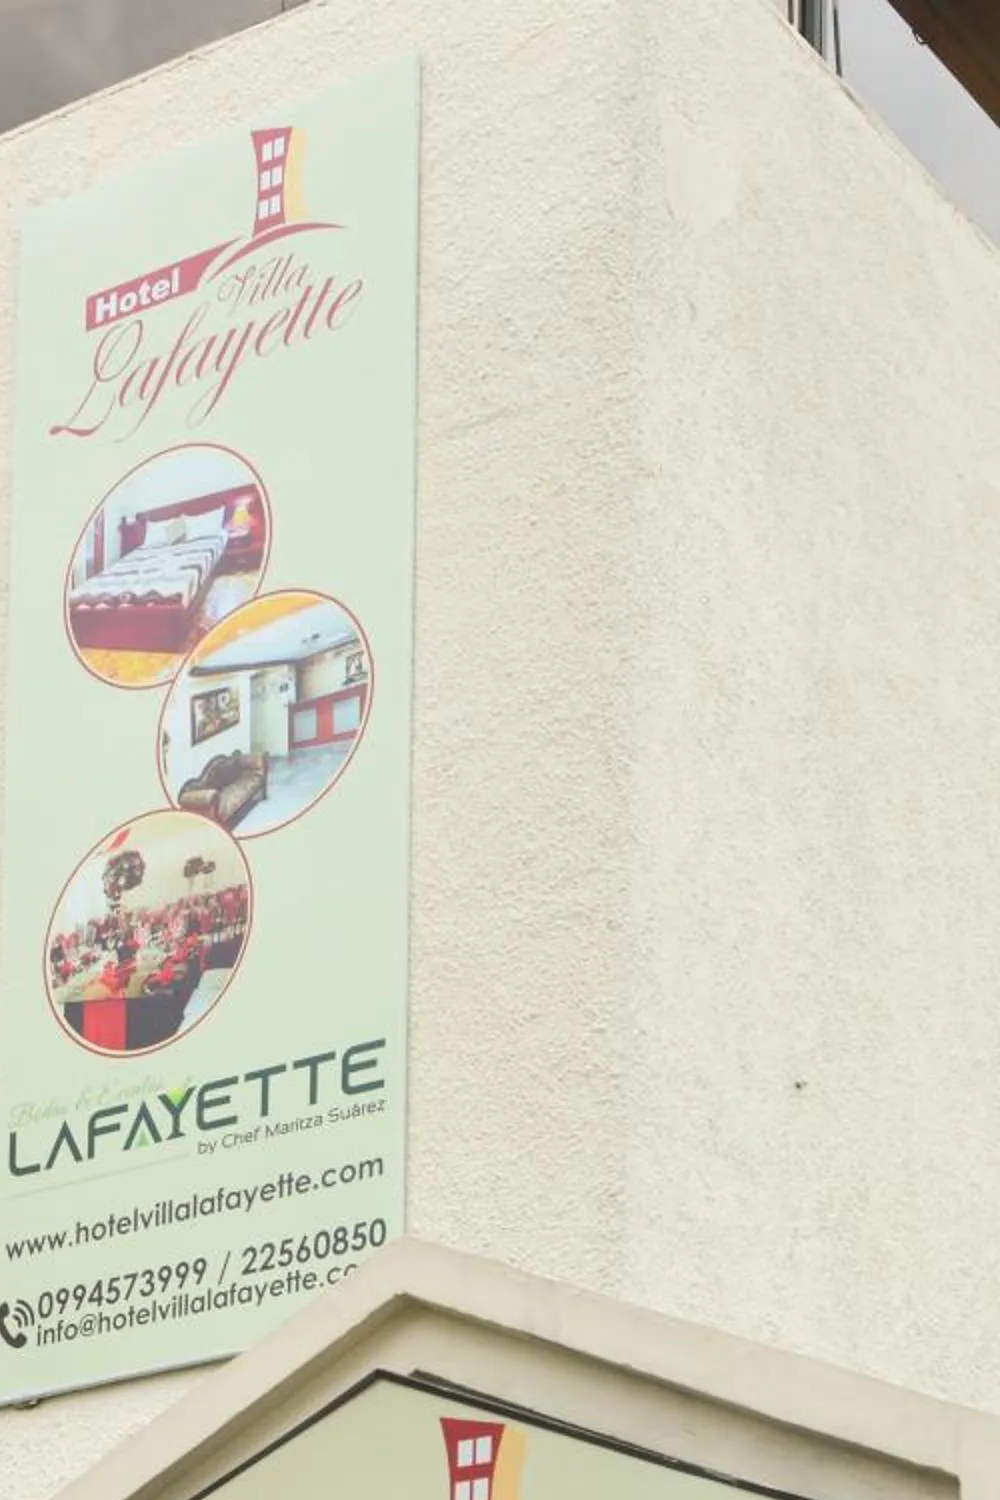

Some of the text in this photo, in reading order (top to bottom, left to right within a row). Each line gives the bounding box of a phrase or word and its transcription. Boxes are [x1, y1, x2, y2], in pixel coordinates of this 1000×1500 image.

[94, 269, 180, 323] Hotel
[217, 253, 309, 316] Villa
[49, 276, 364, 443] Lafayette
[8, 1038, 387, 1177] LAFAYETTE
[197, 1140, 218, 1155] by
[221, 1127, 260, 1149] Chef
[265, 1114, 324, 1139] Maritza
[5, 1156, 384, 1261] www.hotelvillalafayette.com
[36, 1263, 358, 1347] info@hotelvillalafayette.c
[37, 1257, 207, 1320] 0994573999
[241, 1218, 387, 1276] 22560850
